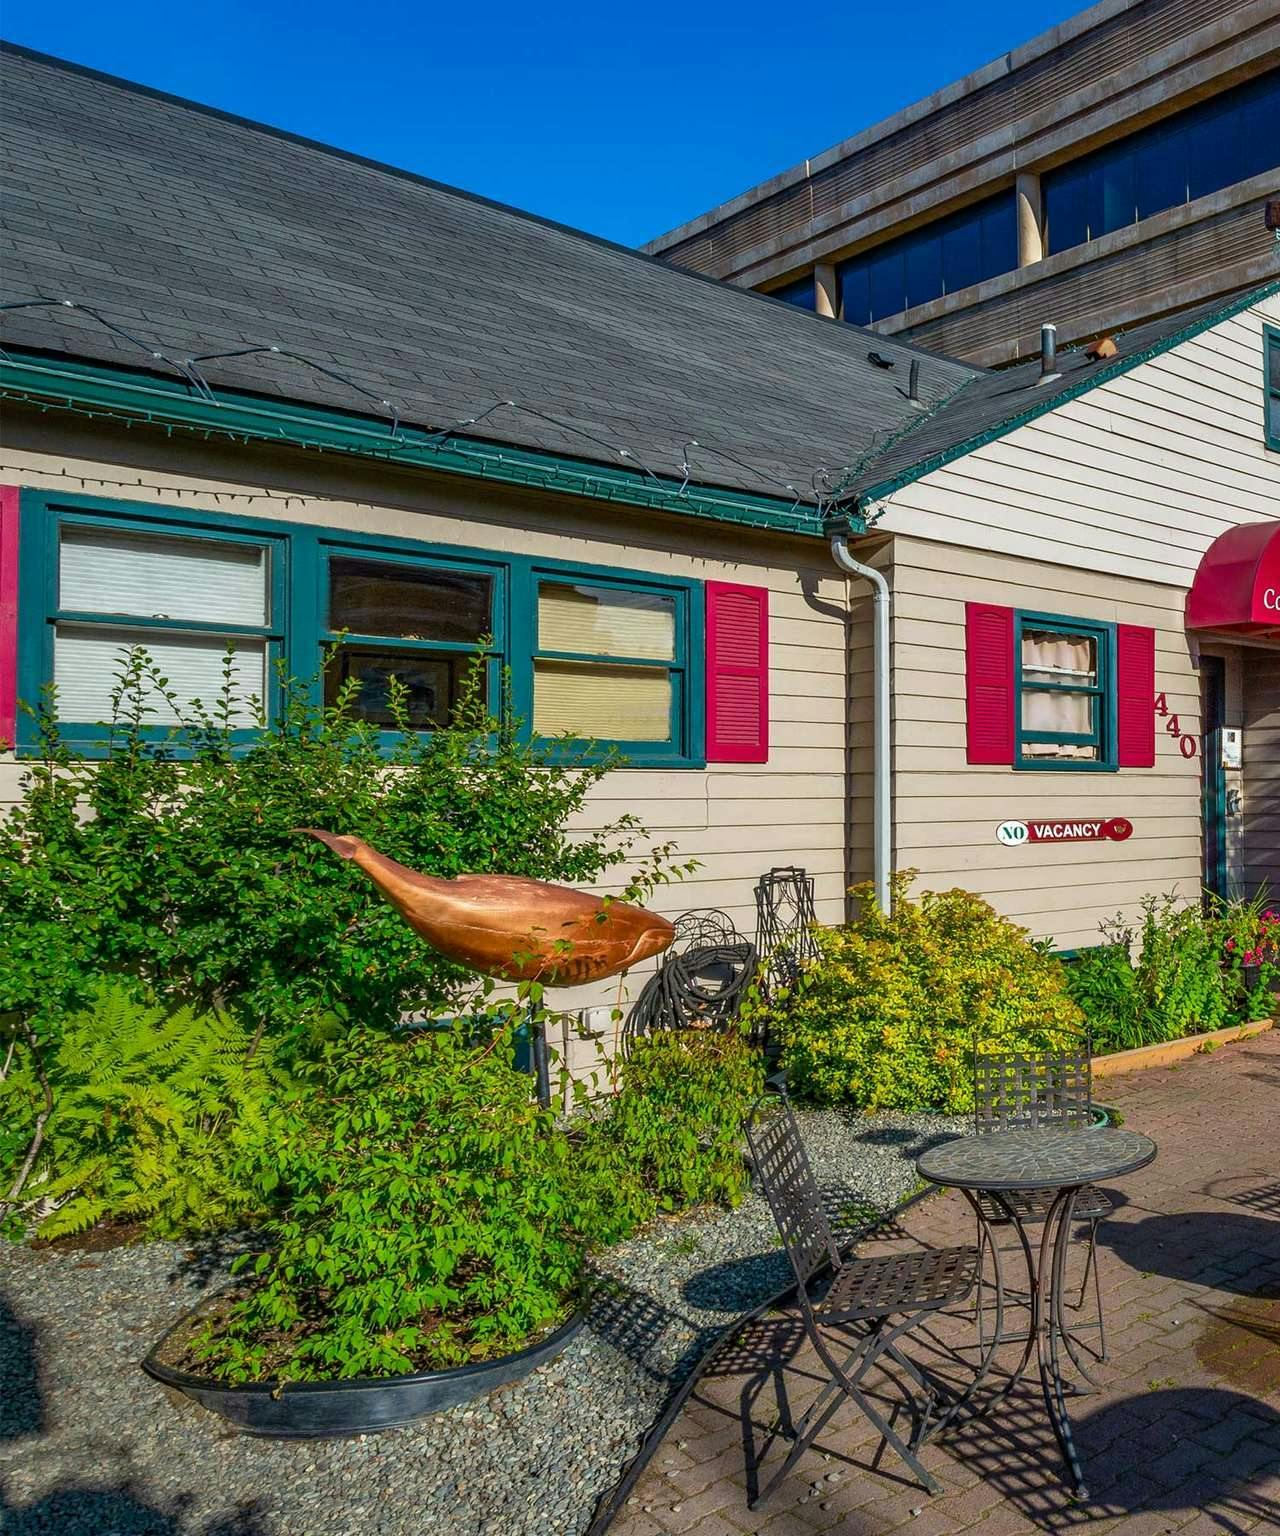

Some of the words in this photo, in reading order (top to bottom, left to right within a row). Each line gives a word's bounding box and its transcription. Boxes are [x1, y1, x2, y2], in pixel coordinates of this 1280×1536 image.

[1154, 692, 1197, 759] 440
[1002, 826, 1025, 840] NO
[1033, 823, 1101, 838] VACANCY
